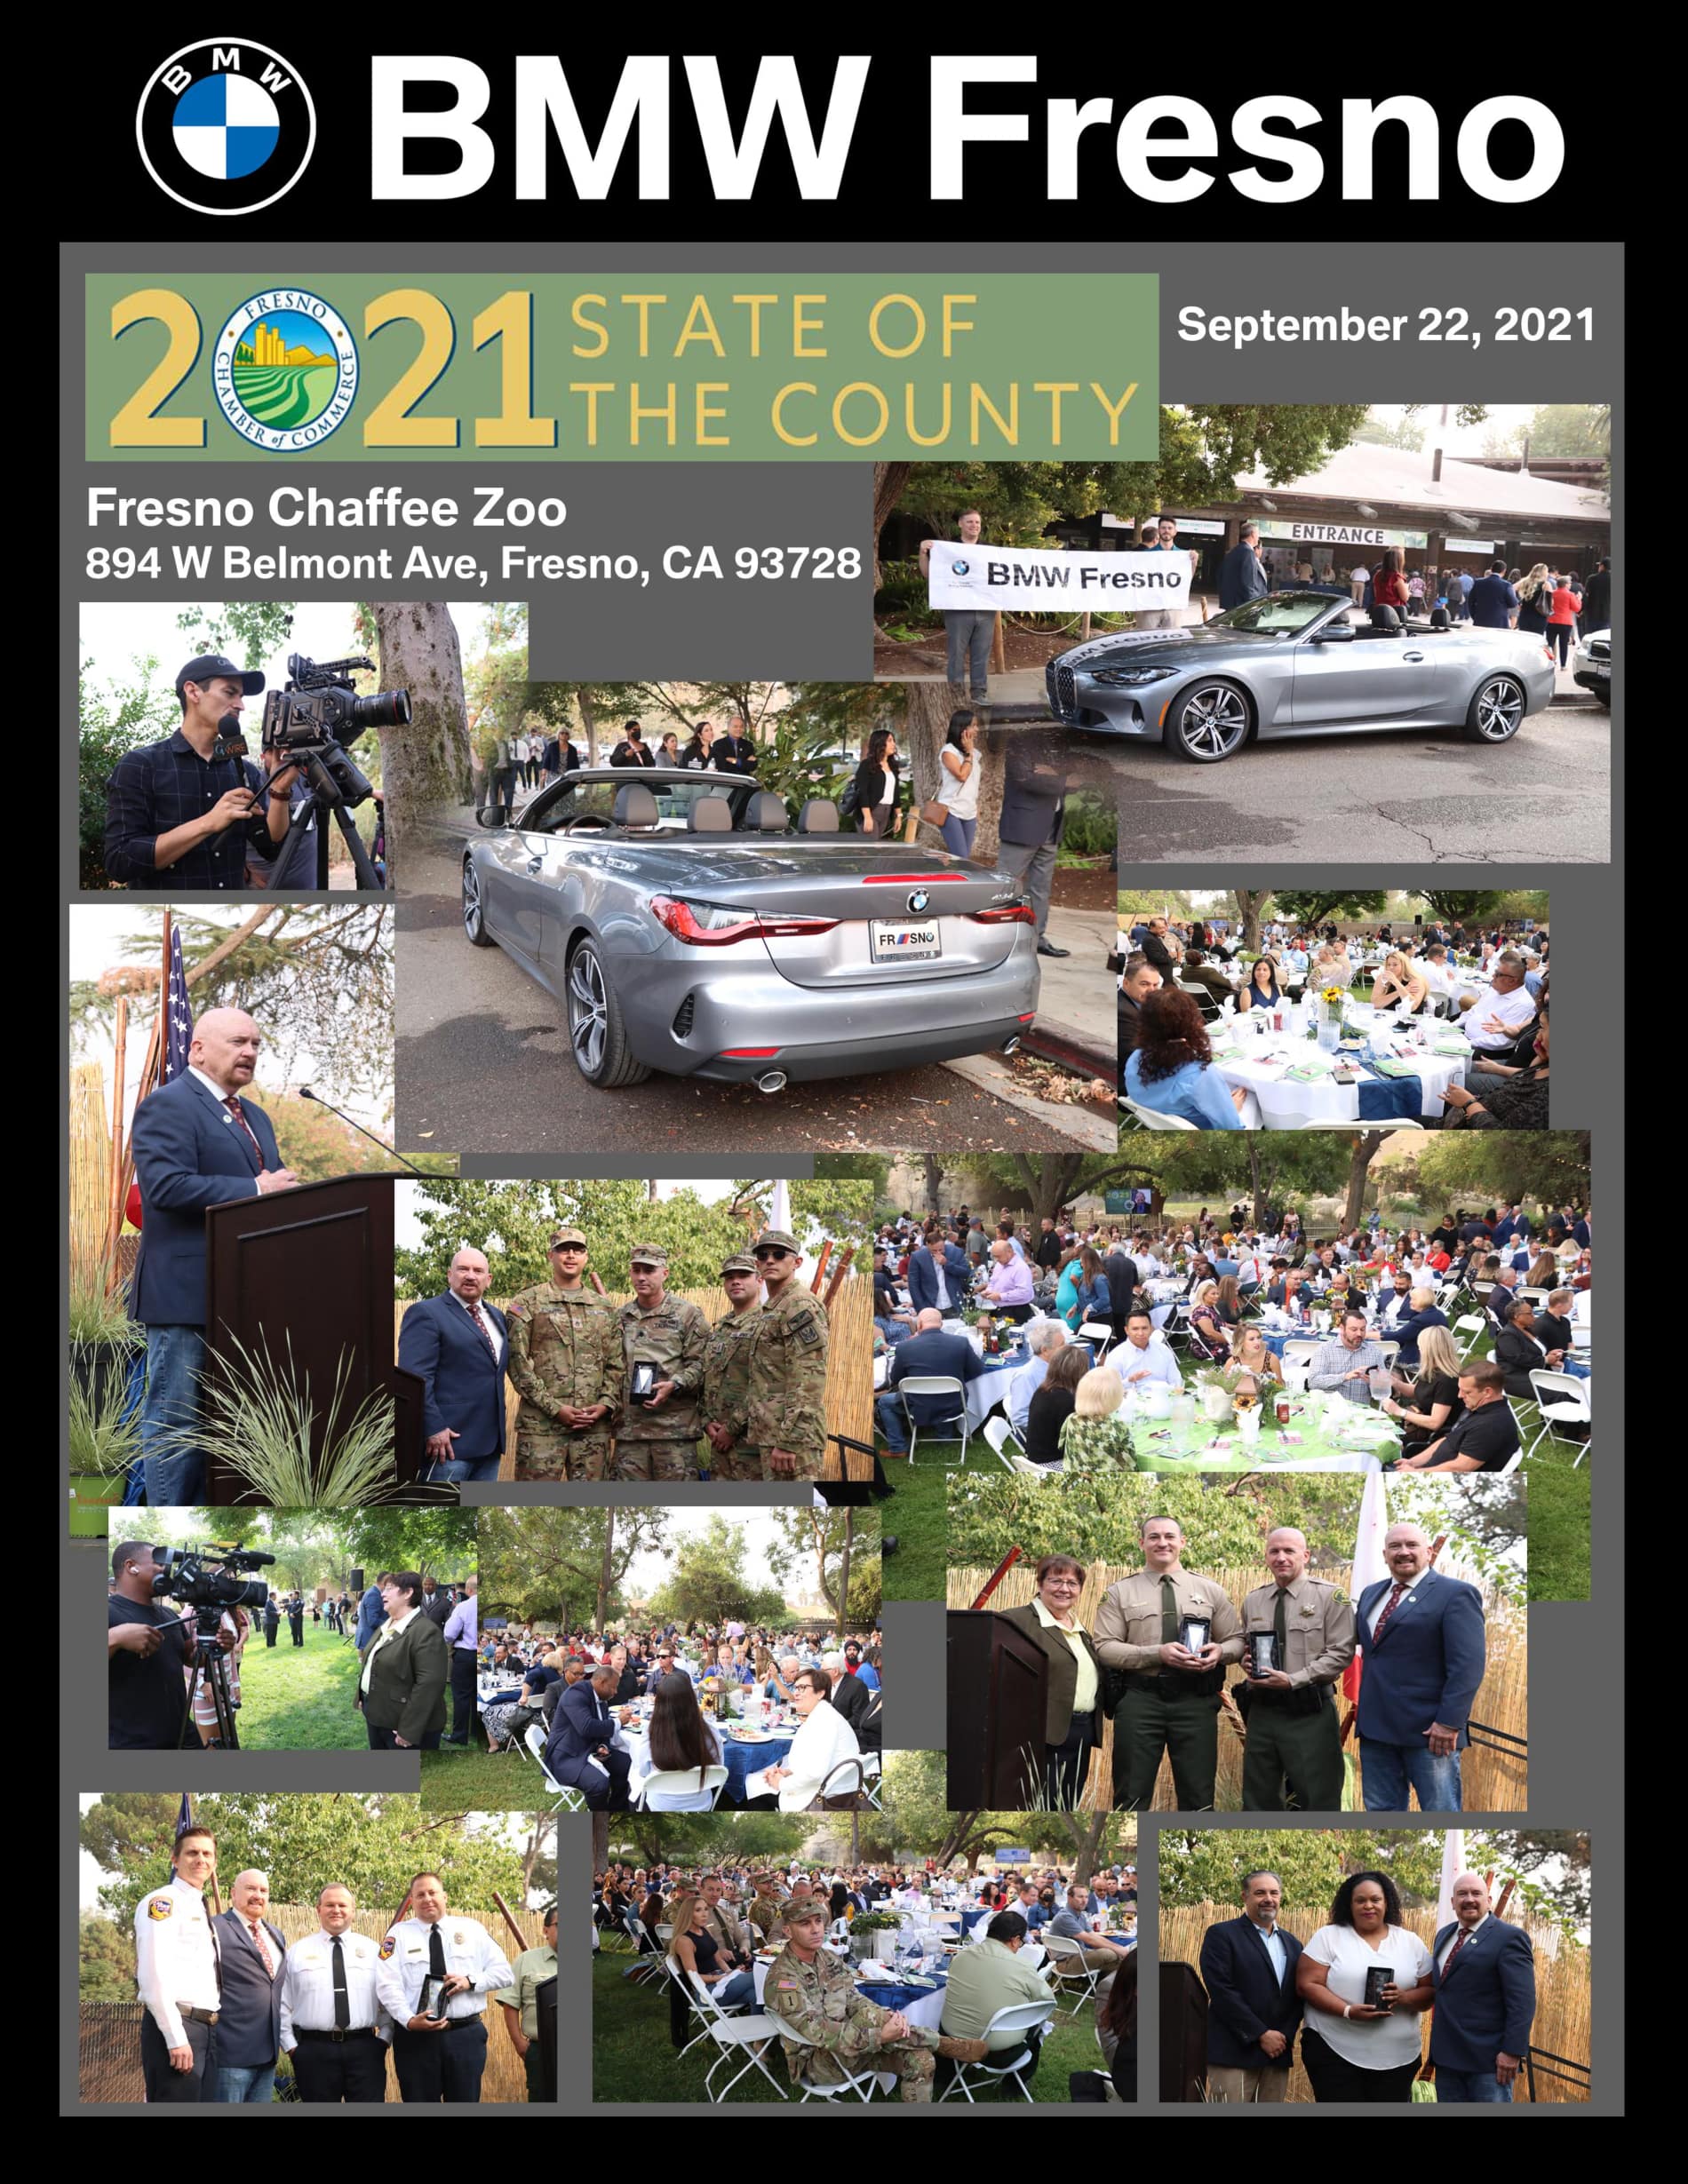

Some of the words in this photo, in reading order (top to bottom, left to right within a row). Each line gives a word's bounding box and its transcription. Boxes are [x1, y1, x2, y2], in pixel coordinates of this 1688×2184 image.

[1292, 524, 1384, 544] ENTRANCE
[987, 562, 1071, 588] BMW
[1080, 568, 1182, 590] Fresno
